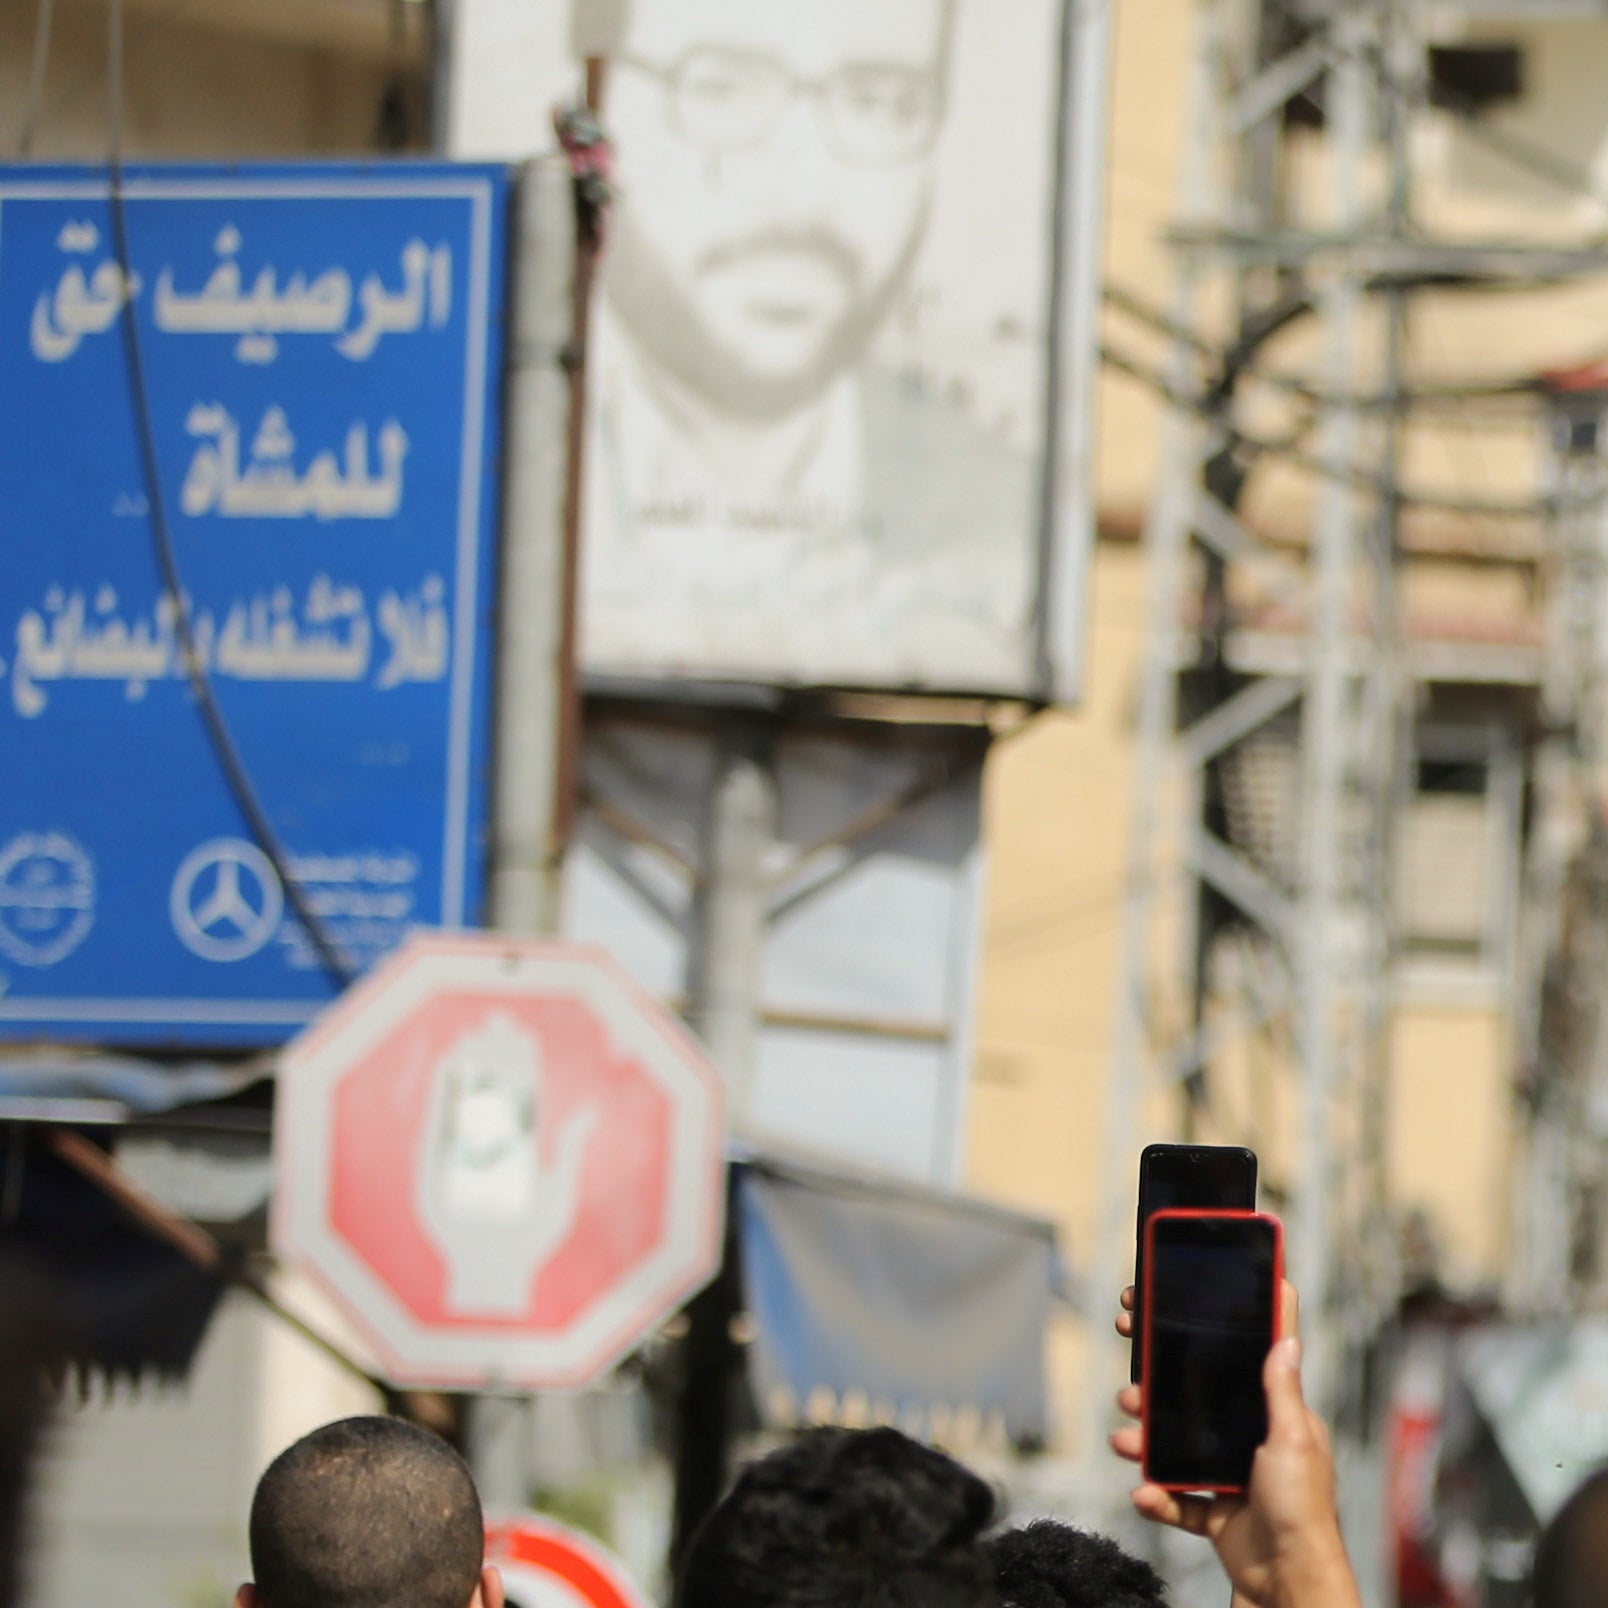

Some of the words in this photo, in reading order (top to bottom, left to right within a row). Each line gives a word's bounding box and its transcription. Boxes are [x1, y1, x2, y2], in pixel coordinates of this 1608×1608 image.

[30, 220, 141, 362] حق
[154, 224, 452, 364] الرصيف
[181, 402, 407, 520] للمشاة
[216, 574, 372, 681] تشغله
[377, 574, 449, 689] فلا
